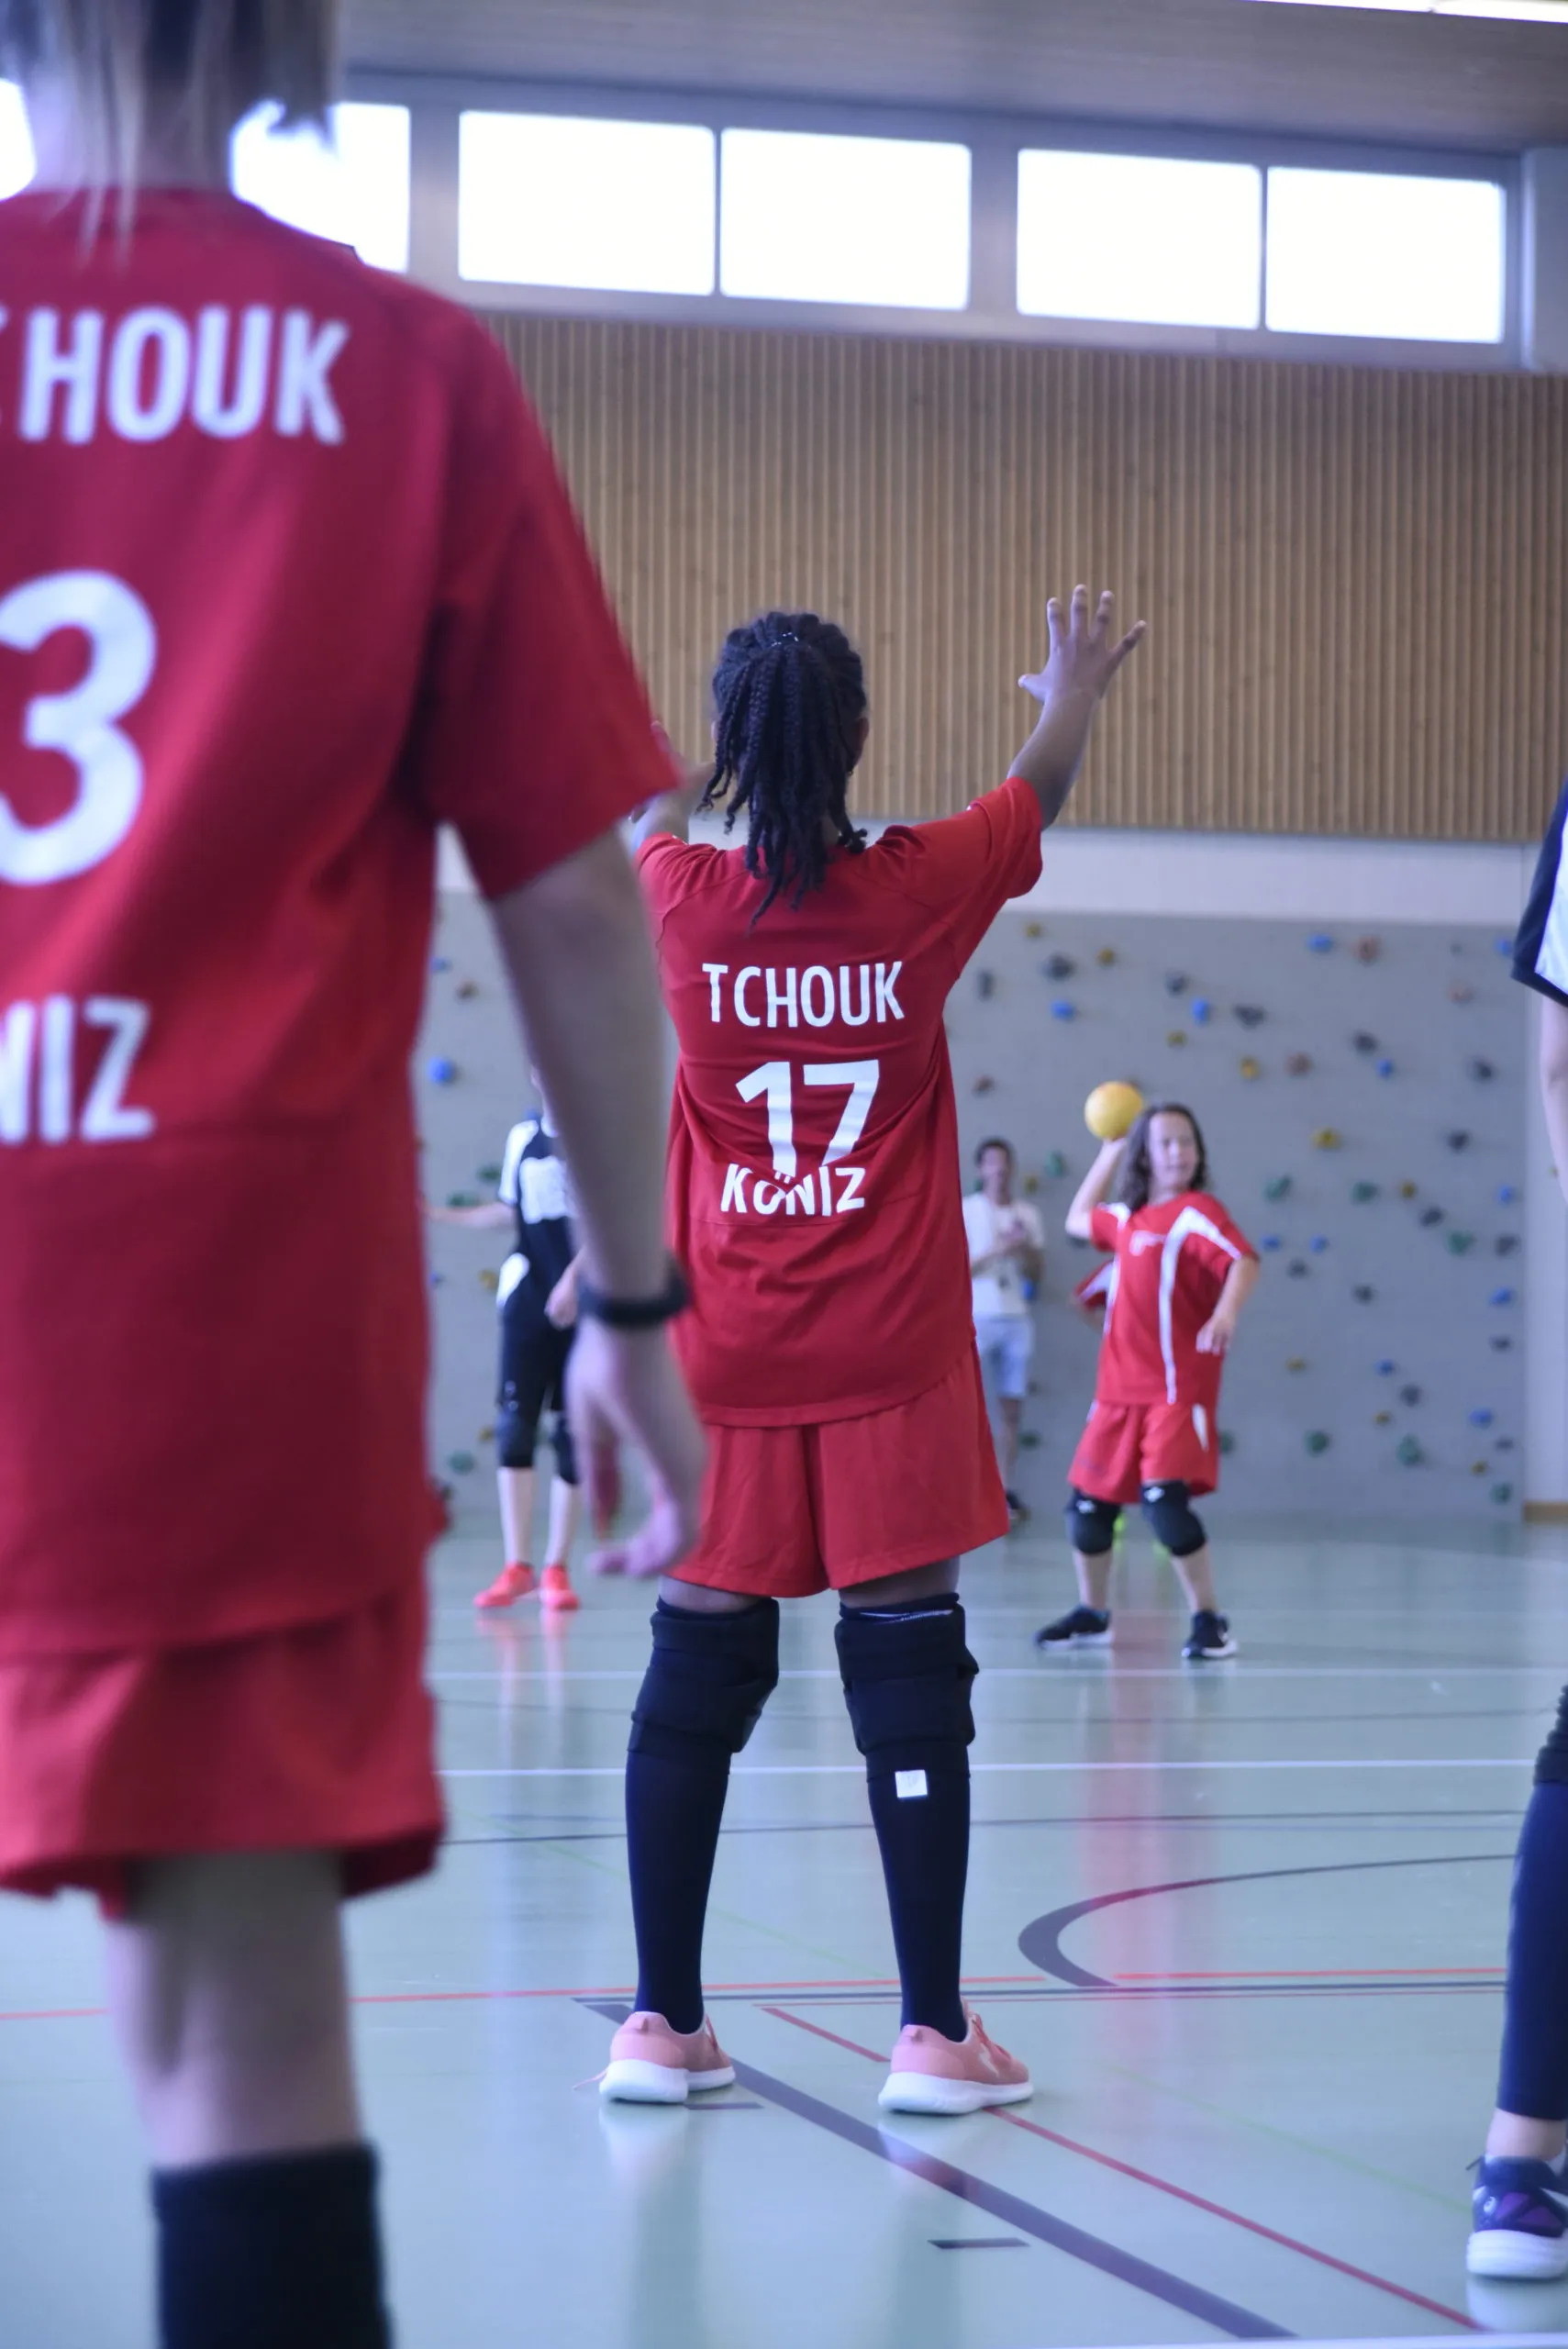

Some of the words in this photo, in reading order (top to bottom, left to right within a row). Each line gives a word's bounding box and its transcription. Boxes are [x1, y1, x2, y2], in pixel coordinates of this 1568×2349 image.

[0, 305, 347, 444] HOUK
[0, 570, 156, 885] 3
[702, 961, 905, 1028] TCHOUK
[735, 1059, 880, 1177] 17
